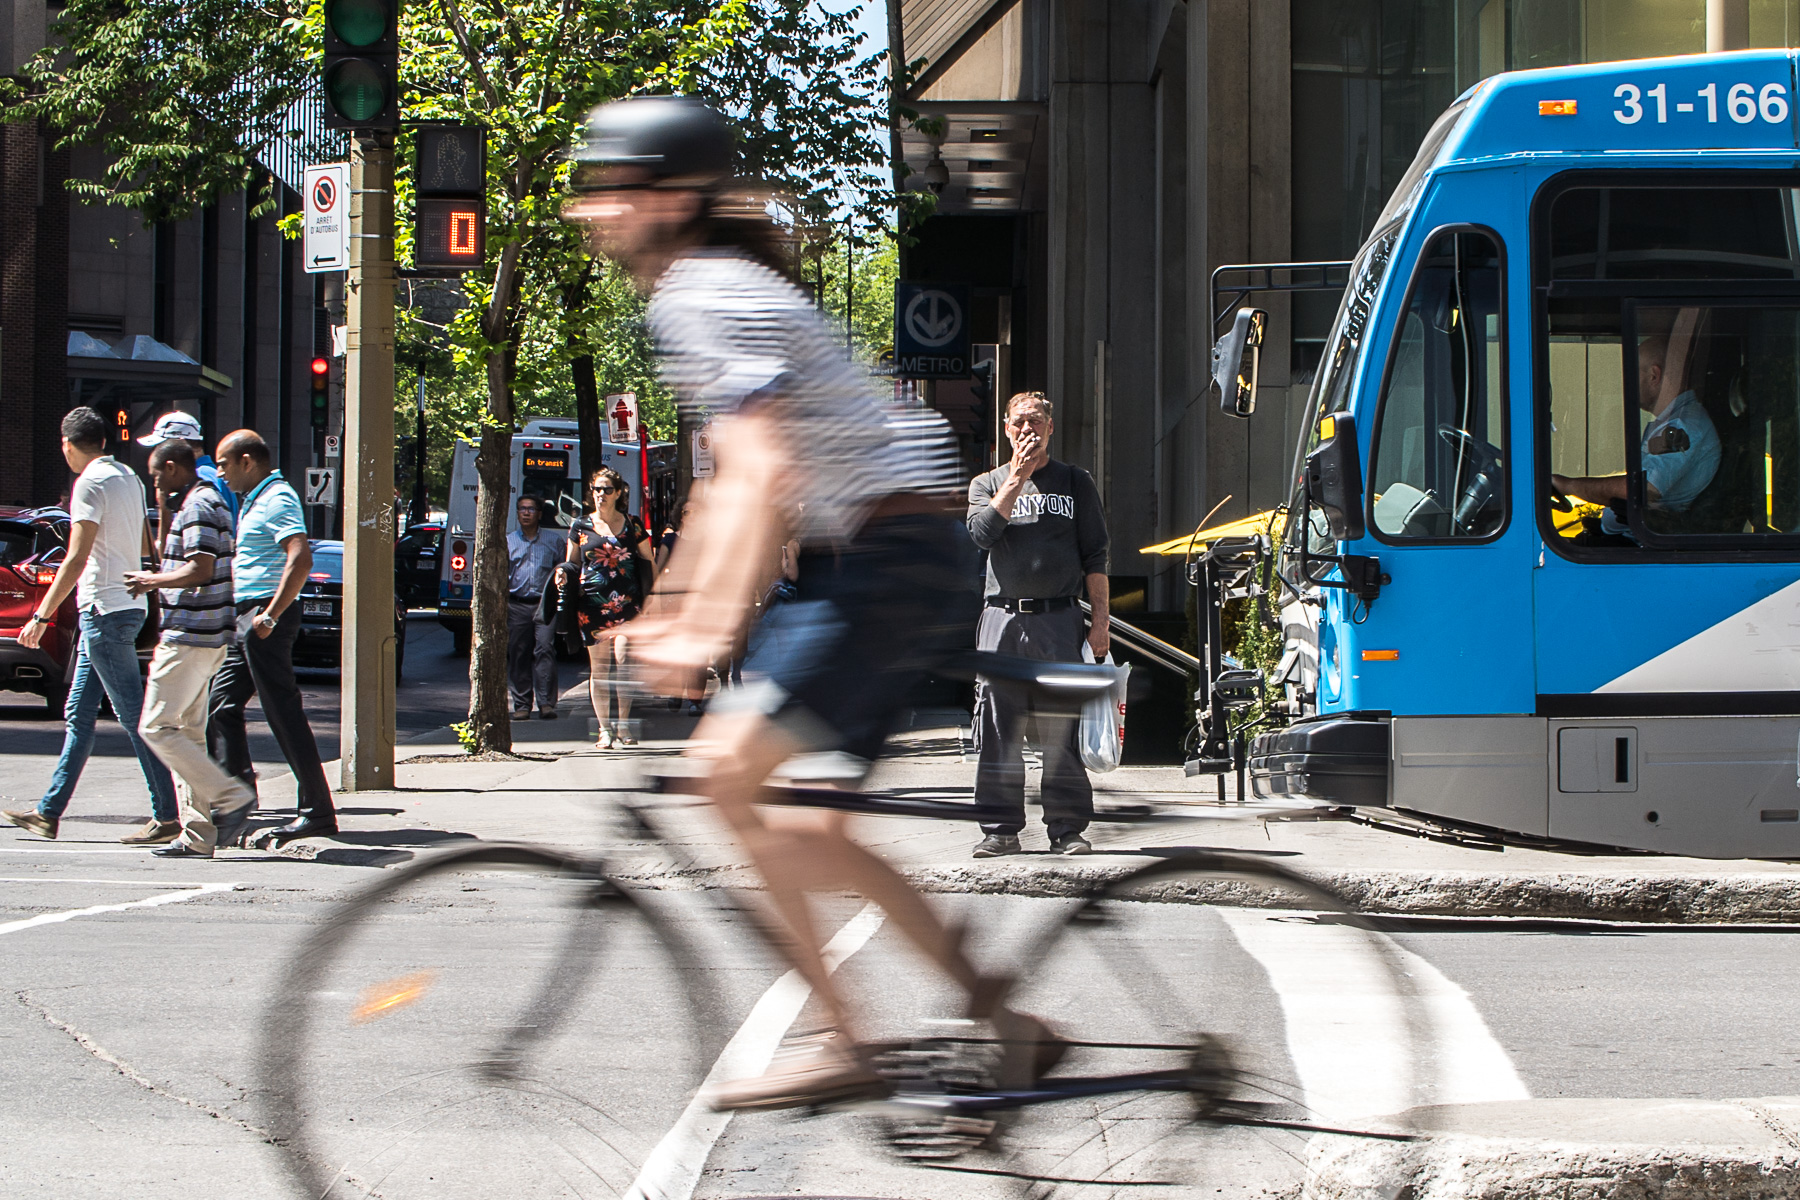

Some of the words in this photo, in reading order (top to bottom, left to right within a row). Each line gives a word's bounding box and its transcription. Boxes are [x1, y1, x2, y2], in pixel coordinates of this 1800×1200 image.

[1613, 83, 1788, 124] 31-166
[316, 215, 332, 224] ARRÊT
[310, 225, 338, 234] D'AUTOBUS
[526, 458, 535, 466] En
[537, 458, 564, 468] transit
